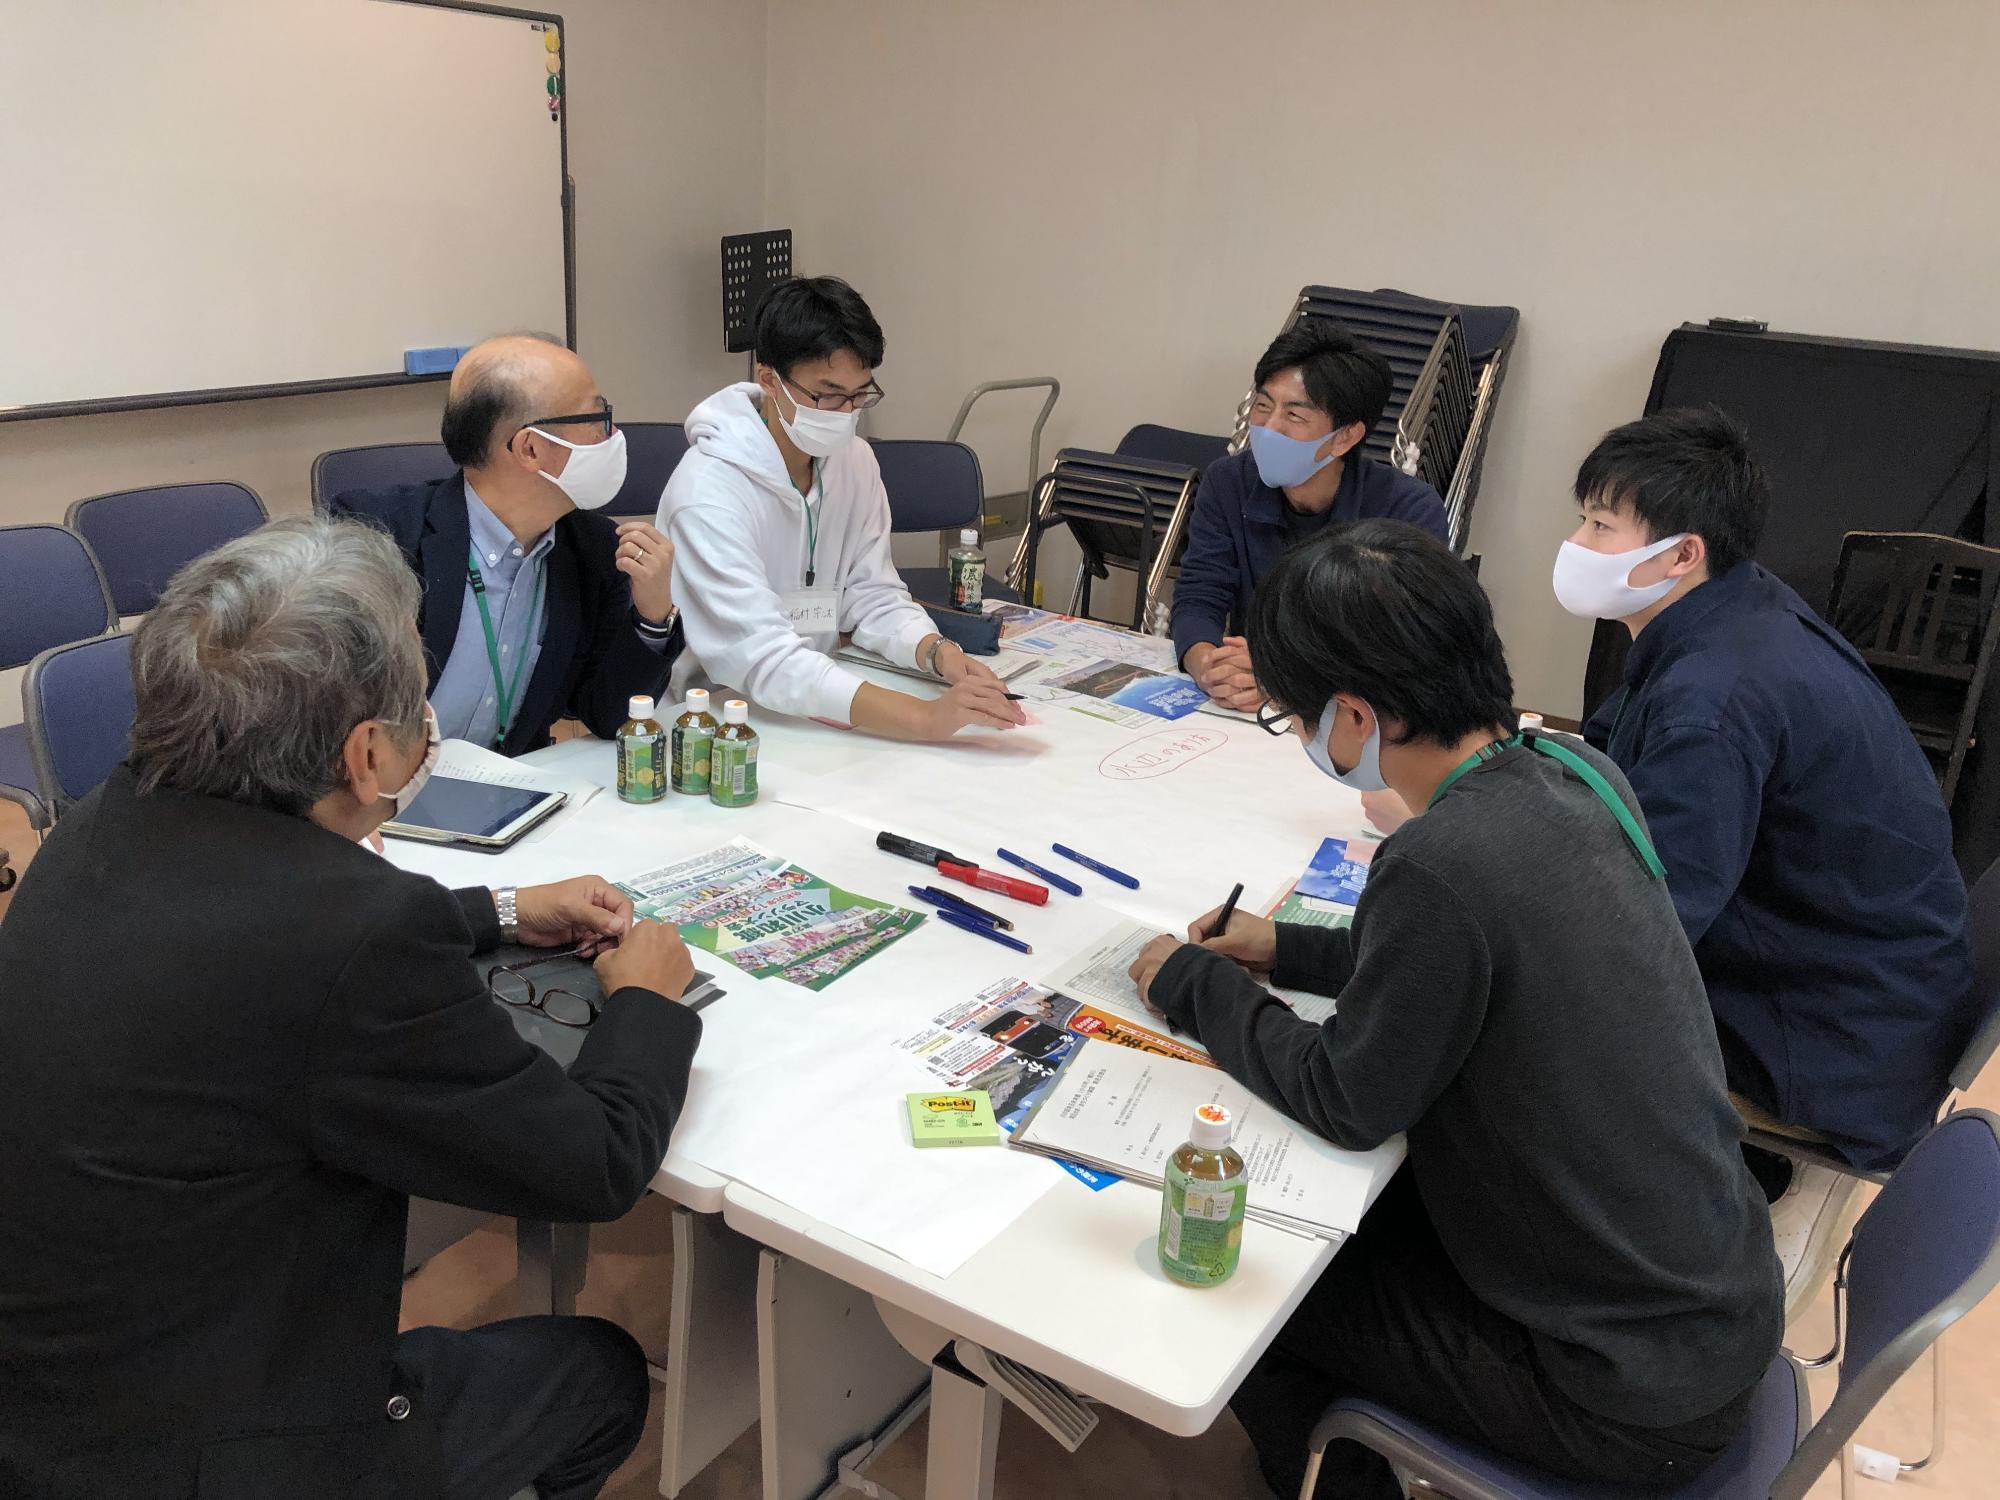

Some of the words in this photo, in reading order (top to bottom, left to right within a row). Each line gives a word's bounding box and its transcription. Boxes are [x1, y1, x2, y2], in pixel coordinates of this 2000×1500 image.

[724, 900, 810, 931] マラソン大会
[732, 904, 826, 942] 小川和紙
[927, 1098, 973, 1108] Post-it
